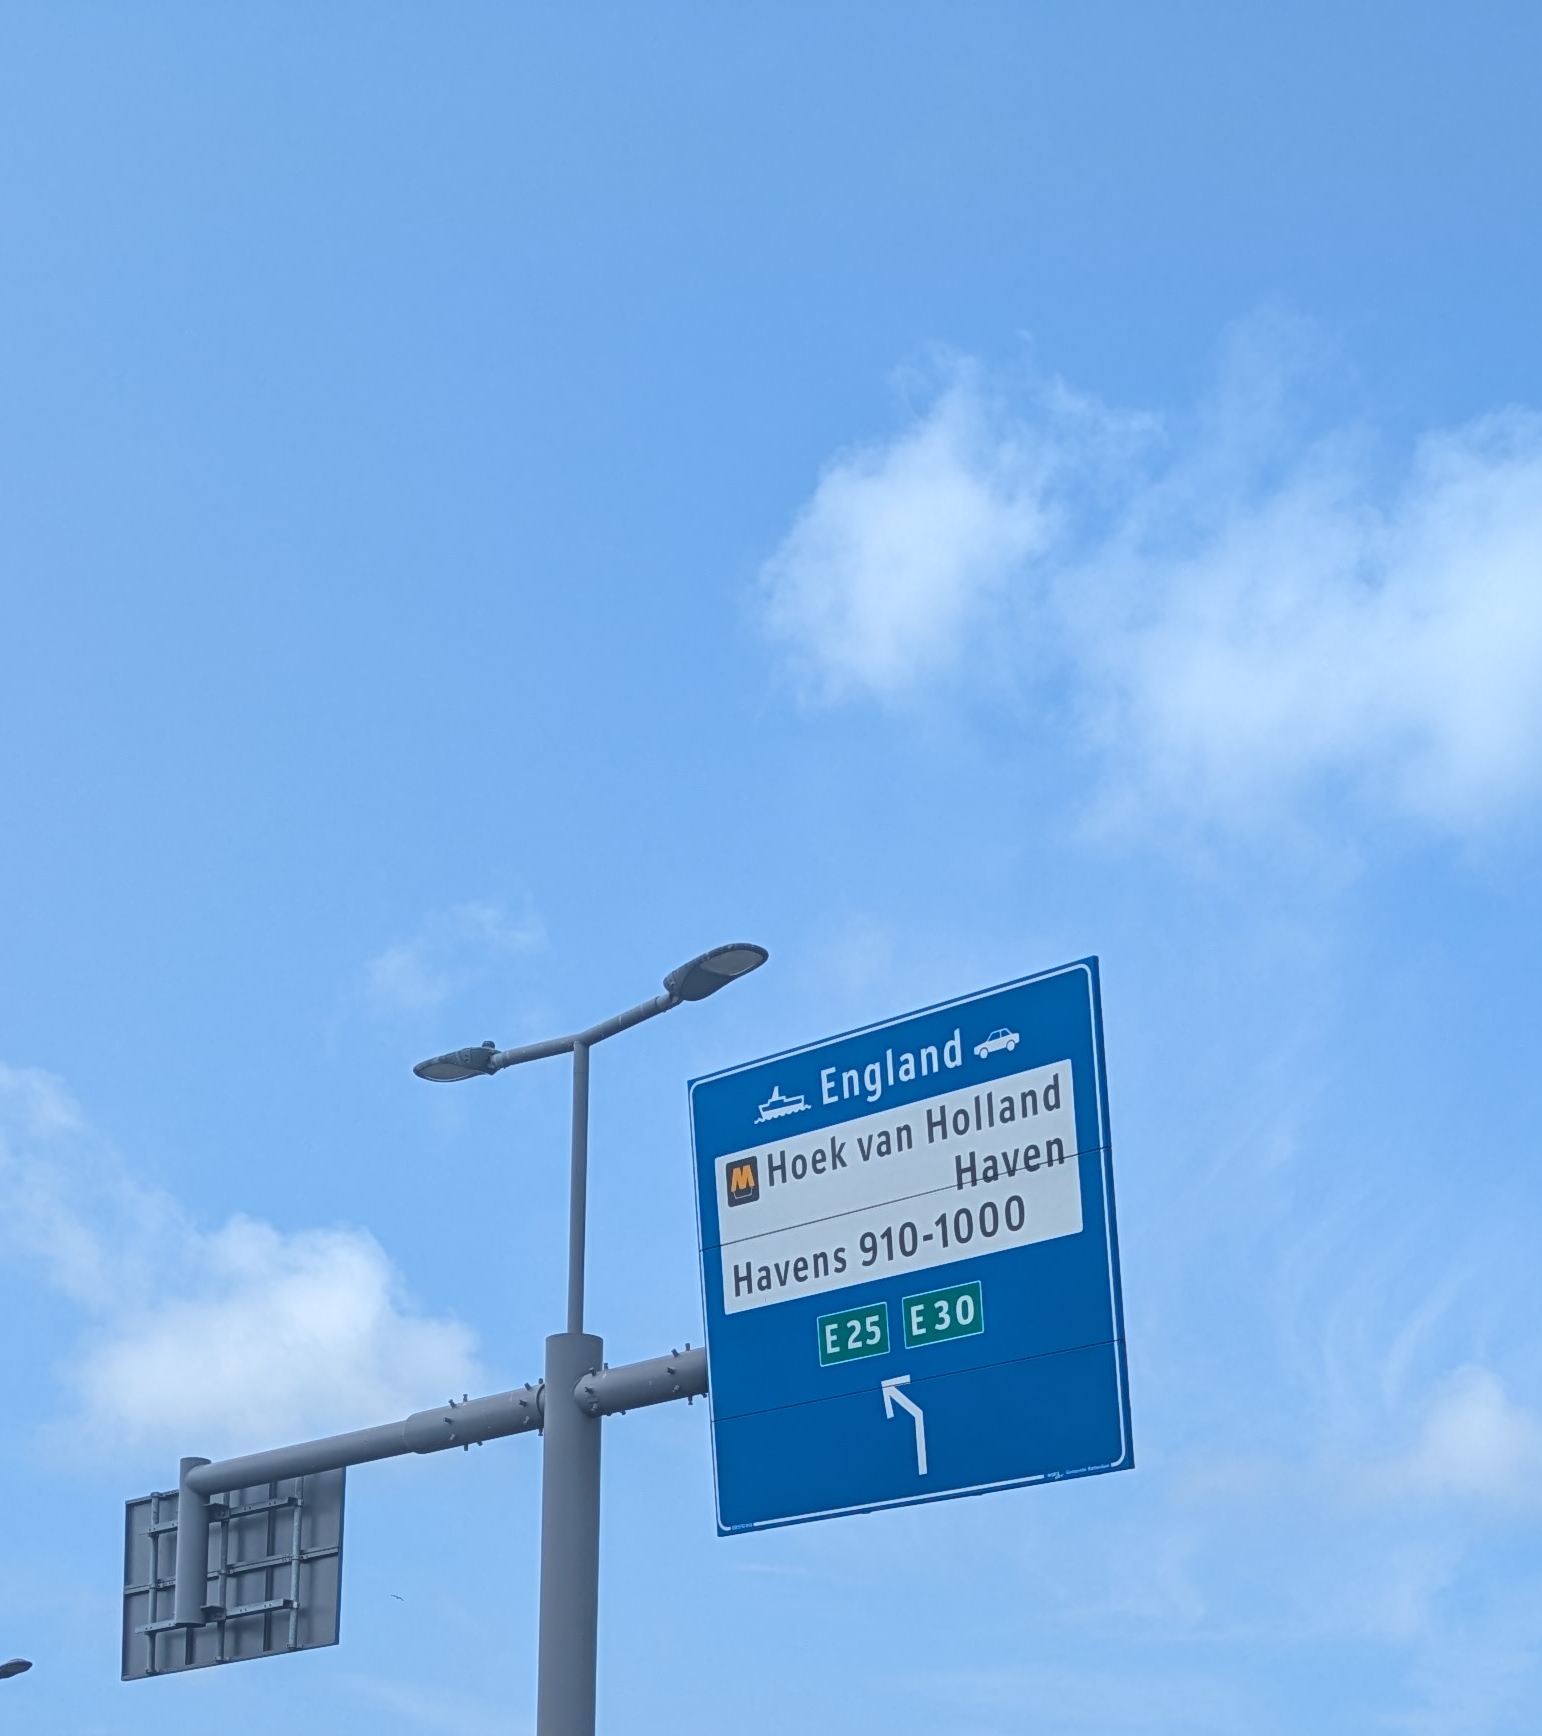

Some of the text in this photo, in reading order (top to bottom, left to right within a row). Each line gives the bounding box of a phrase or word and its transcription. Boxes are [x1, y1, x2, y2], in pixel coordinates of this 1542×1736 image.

[820, 1029, 963, 1105] England
[767, 1073, 1062, 1188] Hoek van Holland
[955, 1137, 1066, 1191] Haven
[733, 1195, 1026, 1298] Havens 910-1000
[826, 1314, 881, 1354] E 25
[911, 1294, 975, 1336] E 30
